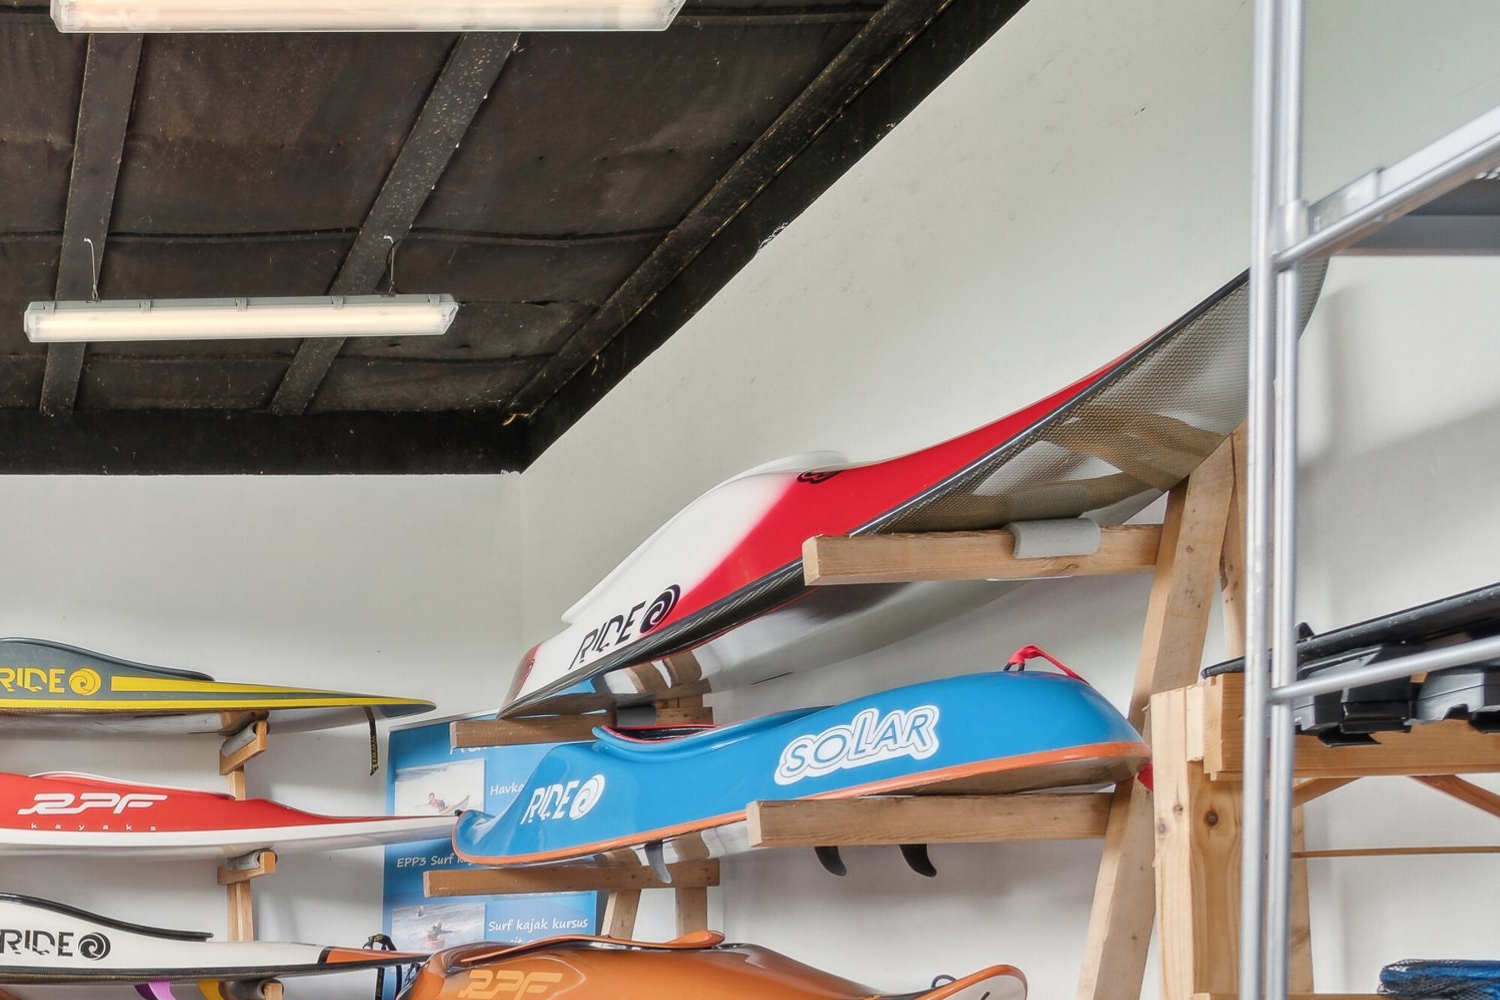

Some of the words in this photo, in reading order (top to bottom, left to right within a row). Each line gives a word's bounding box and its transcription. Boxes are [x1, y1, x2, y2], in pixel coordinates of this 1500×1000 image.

[568, 600, 647, 670] RIDE
[779, 708, 935, 777] SOLAR
[520, 780, 580, 825] RIDE
[30, 823, 157, 832] kayaks
[396, 856, 427, 868] EPP3
[430, 852, 455, 865] Surf
[488, 919, 513, 931] Surf
[516, 918, 548, 933] kajak
[552, 917, 588, 929] kursus
